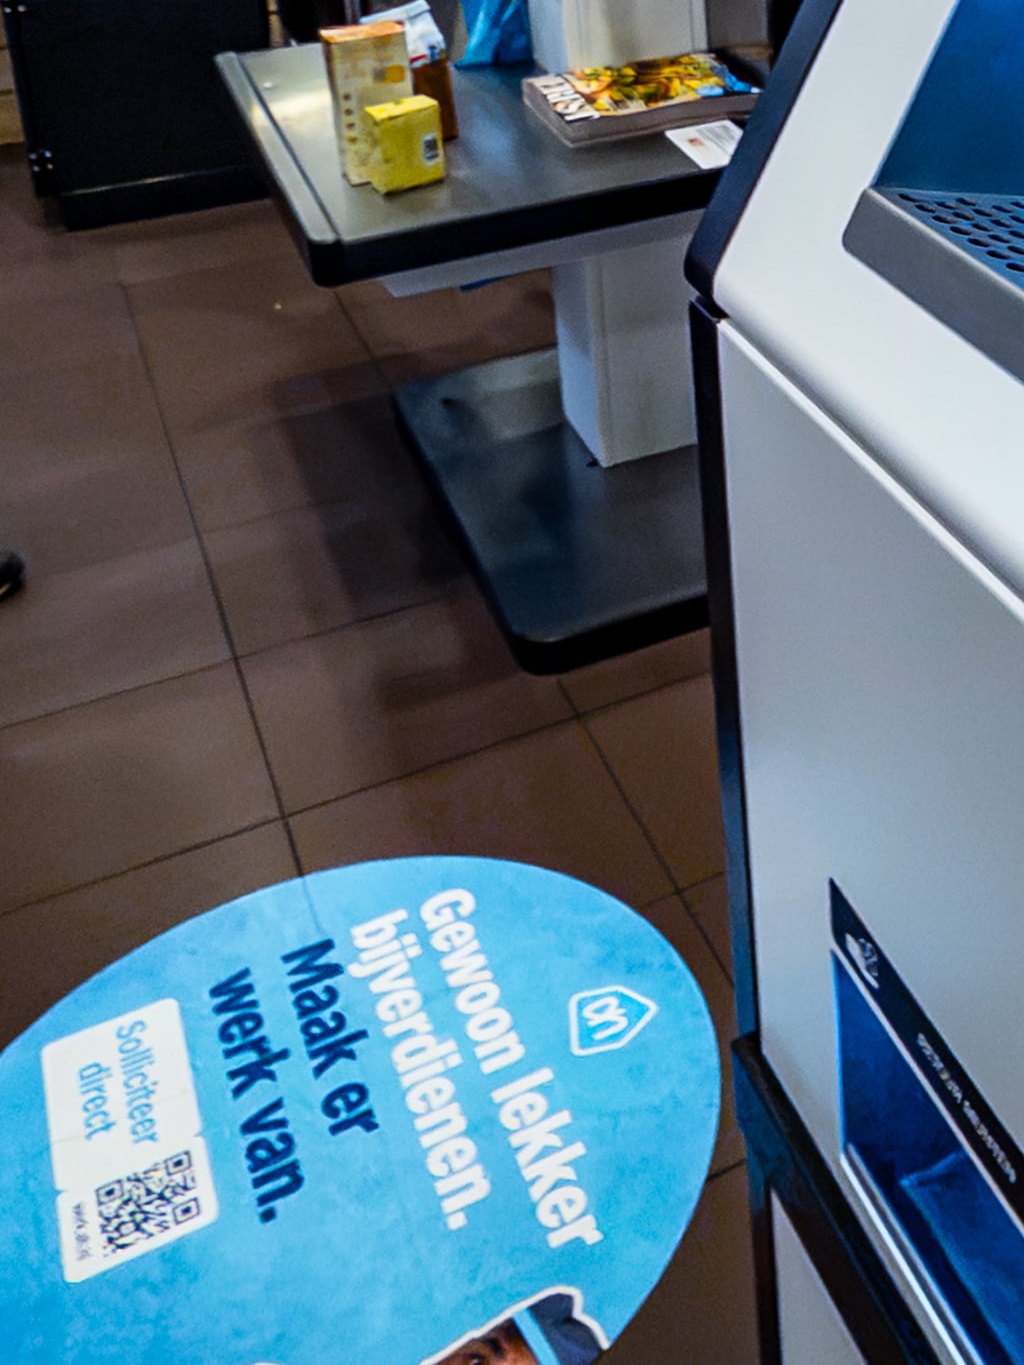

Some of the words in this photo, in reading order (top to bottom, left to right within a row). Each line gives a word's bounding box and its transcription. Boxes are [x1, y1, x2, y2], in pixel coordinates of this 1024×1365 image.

[208, 967, 292, 1101] werk
[280, 938, 370, 1081] Maak
[347, 908, 493, 1231] bijverdienen.
[419, 887, 527, 1076] Gewoon
[489, 1066, 605, 1250] lekker
[78, 1062, 116, 1141] direct
[116, 1019, 159, 1145] Solliciteer
[320, 1082, 380, 1136] er
[239, 1095, 305, 1224] van.
